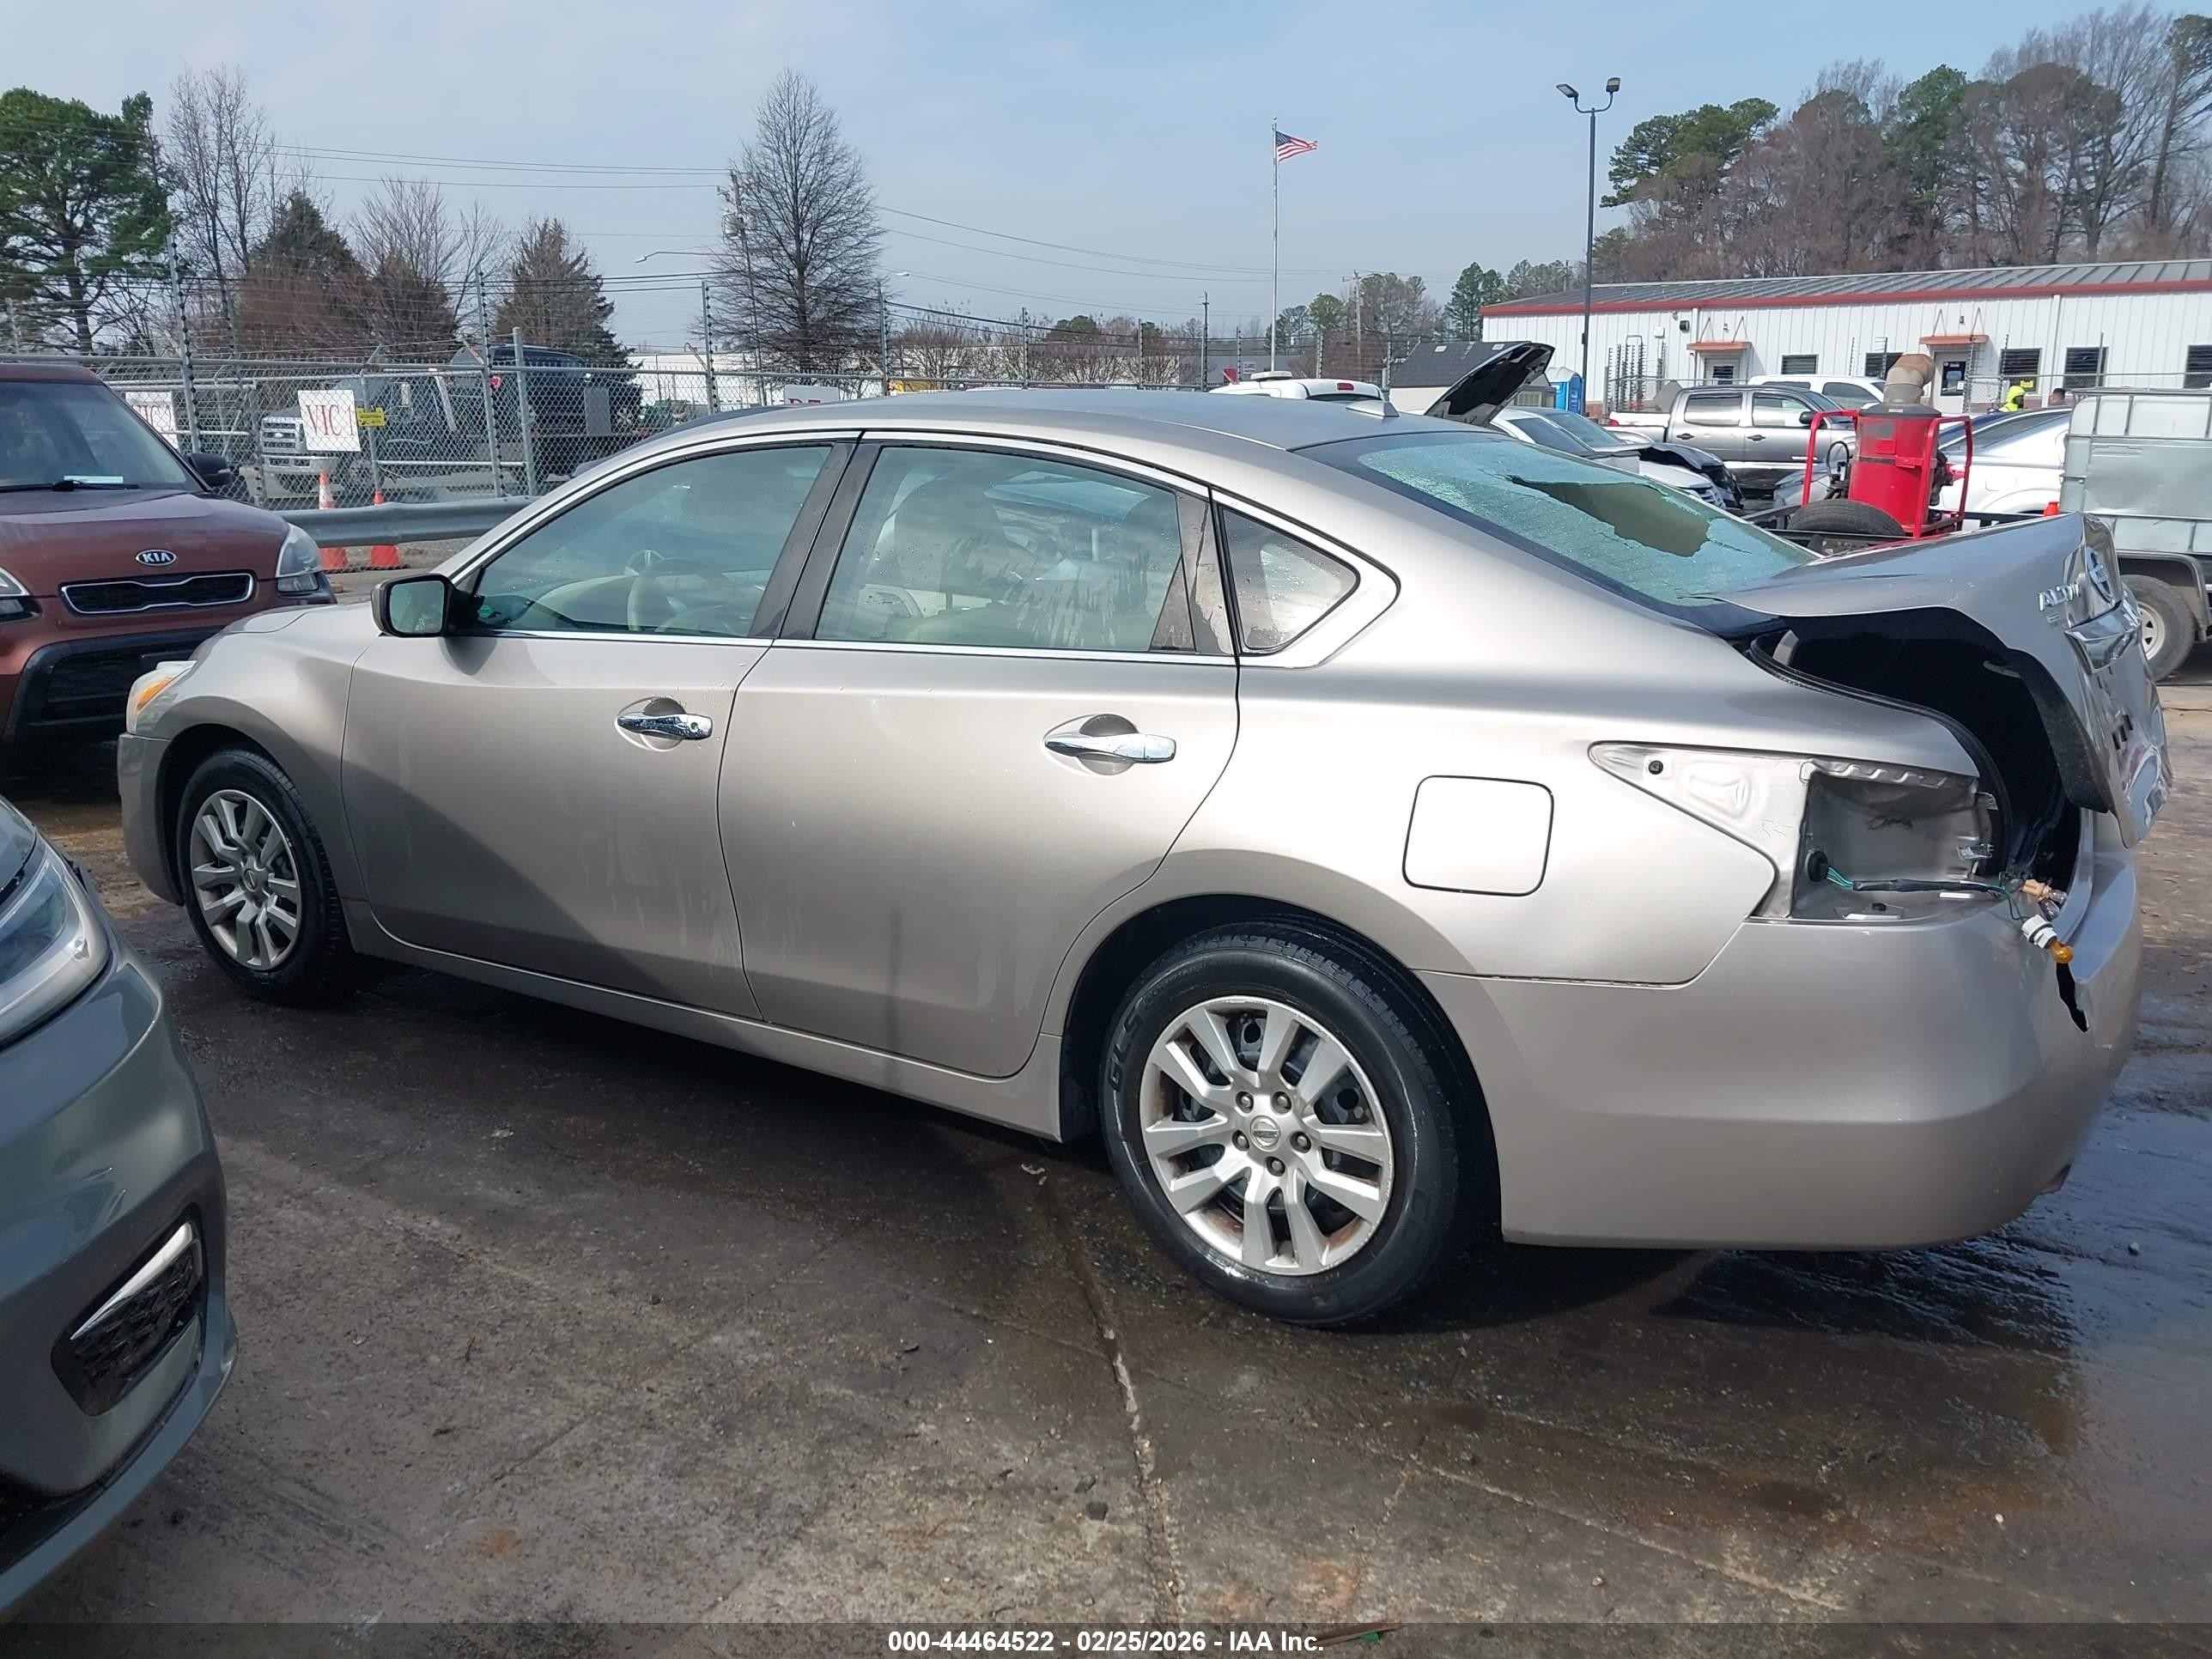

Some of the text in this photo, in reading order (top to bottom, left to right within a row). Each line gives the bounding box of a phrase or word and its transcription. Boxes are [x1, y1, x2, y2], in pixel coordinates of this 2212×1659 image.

[305, 404, 343, 436] VIC
[346, 404, 356, 436] 1
[143, 552, 172, 563] KIA
